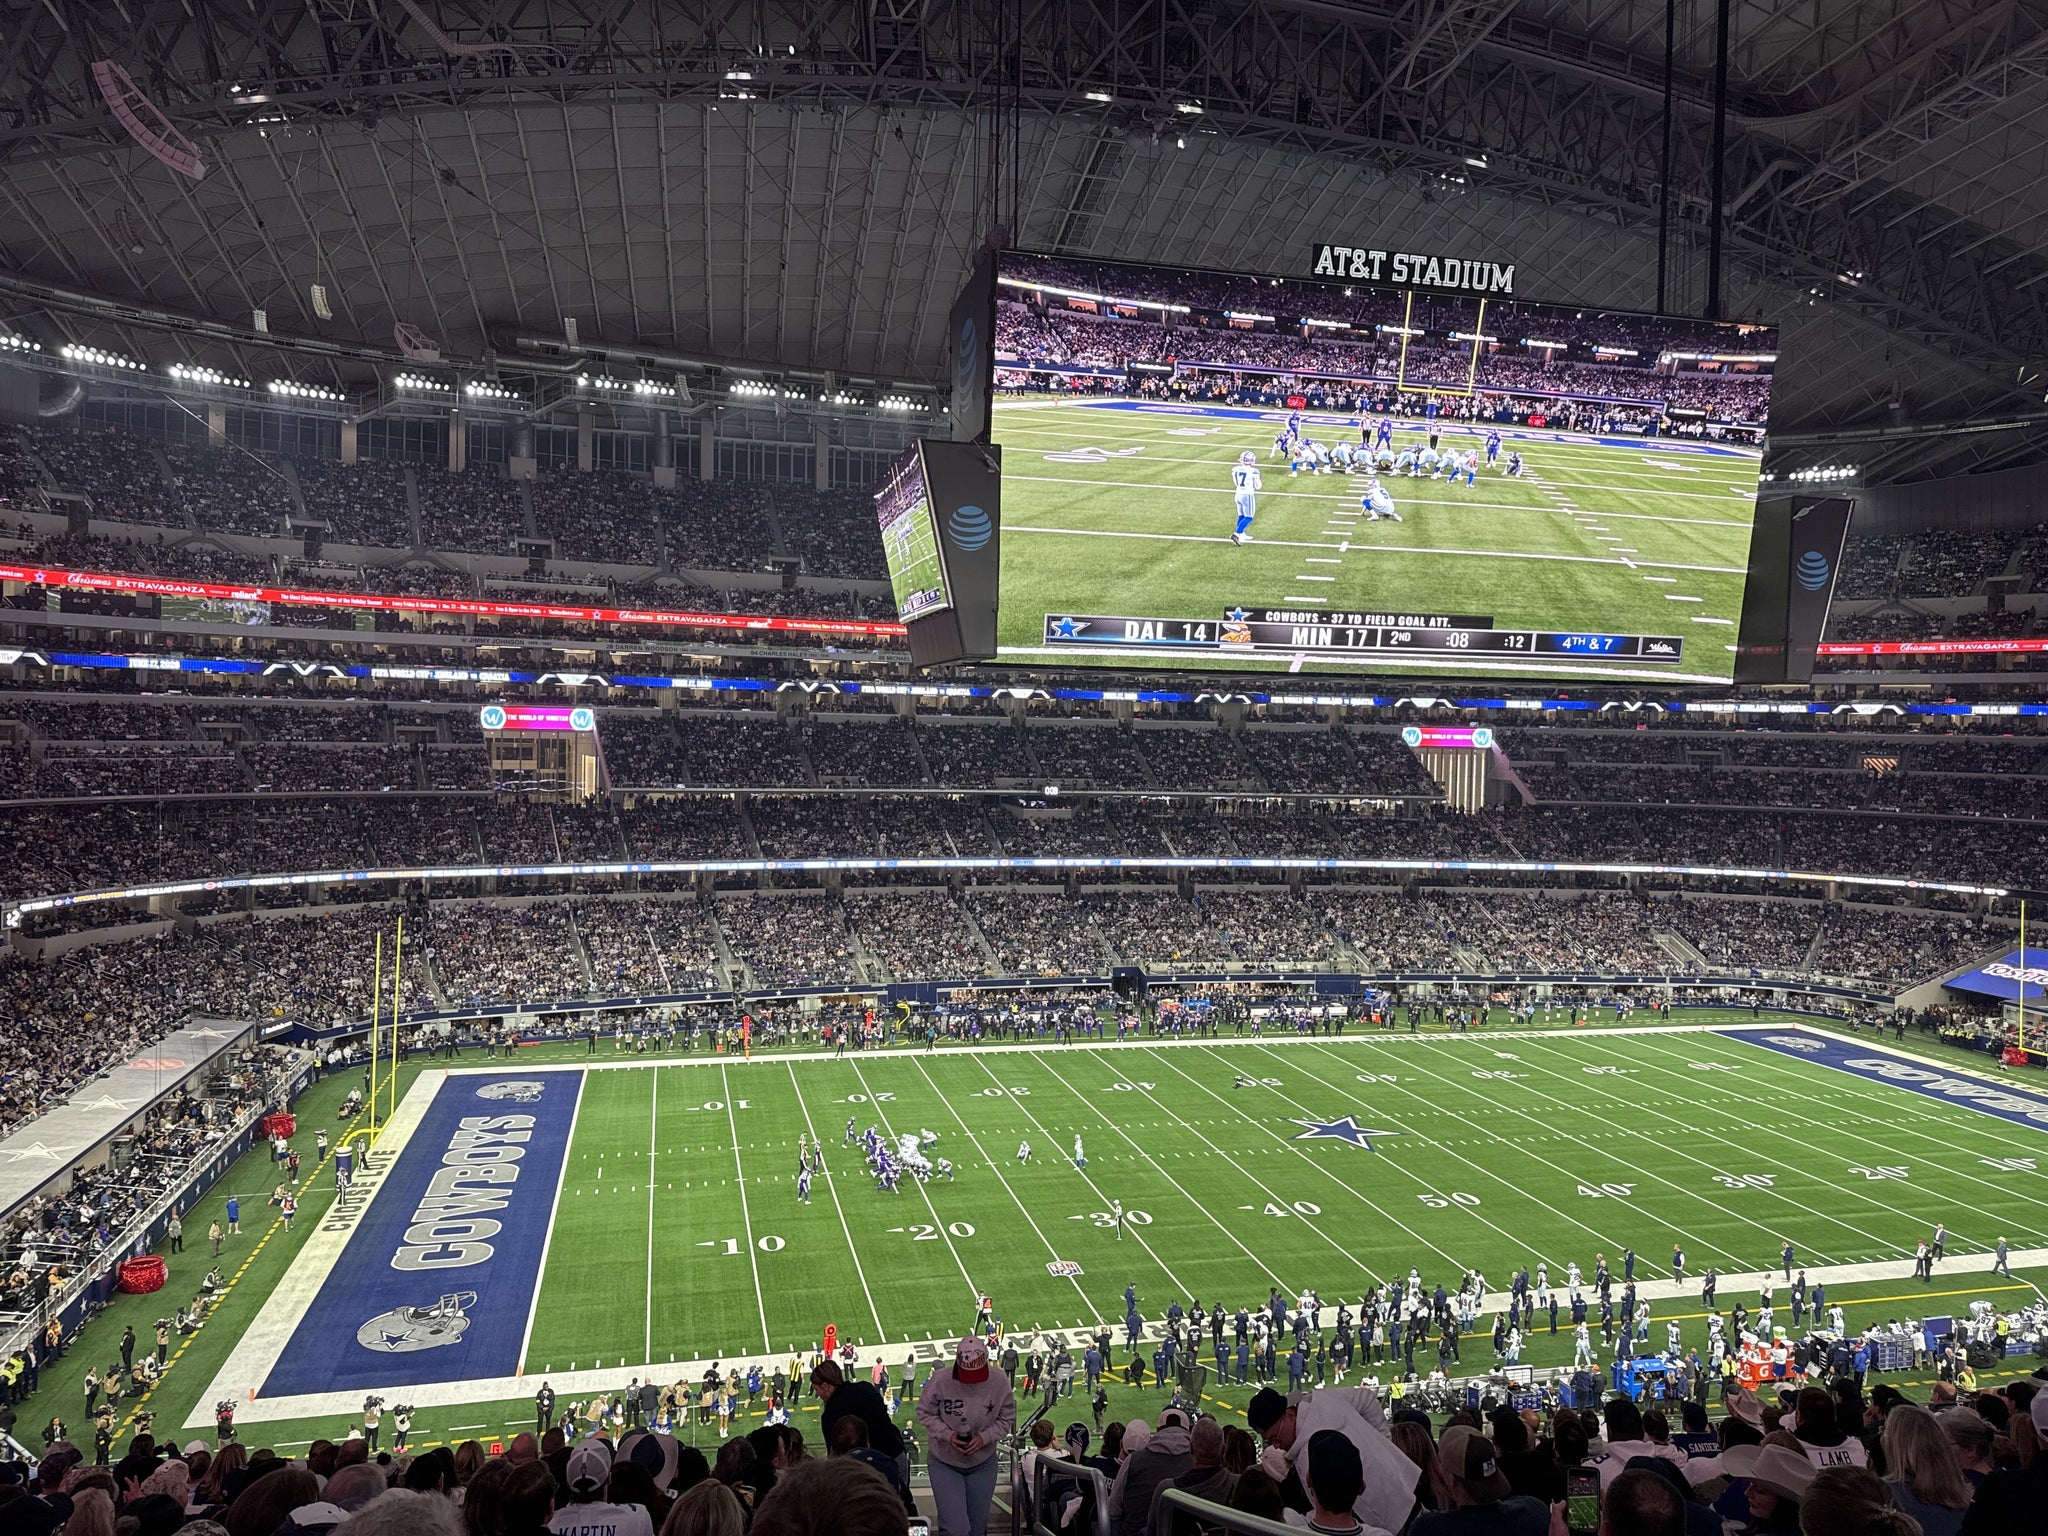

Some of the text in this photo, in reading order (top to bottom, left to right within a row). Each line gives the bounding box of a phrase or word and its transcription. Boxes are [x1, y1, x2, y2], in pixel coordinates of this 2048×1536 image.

[1314, 245, 1516, 293] AT&T STADIUM
[67, 572, 258, 600] Christmas EXTRAVAGANZA reliant
[619, 610, 653, 621] Christmas
[656, 615, 728, 625] EXTRAVAGANZA
[1265, 610, 1319, 624] COWBOYS
[1331, 612, 1344, 624] 37
[1347, 613, 1361, 625] YD
[1365, 614, 1395, 626] FIELD
[1398, 615, 1425, 627] GOAL
[1428, 616, 1452, 628] ATT.
[1124, 620, 1207, 642] DAL 14
[1291, 627, 1613, 651] MIN 17 2ND :08 :12 4TH & 7
[492, 638, 525, 646] JOHNSON
[1939, 642, 2019, 651] EXTRAVAGANZA
[1843, 1059, 2048, 1124] COWB
[1847, 1165, 1909, 1180] 20
[322, 1149, 396, 1233] CHOOSE LOVE
[1577, 1182, 1633, 1198] 40
[1712, 1174, 1775, 1190] 30
[391, 1114, 537, 1271] COWBOYS
[1415, 1191, 1481, 1208] 50
[1262, 1200, 1322, 1218] 40
[1087, 1209, 1155, 1228] 30
[908, 1221, 977, 1242] 20
[721, 1234, 786, 1256] 10
[1980, 1315, 1992, 1326] 97
[1759, 1364, 1770, 1378] G
[1818, 1450, 1852, 1467] LAMB
